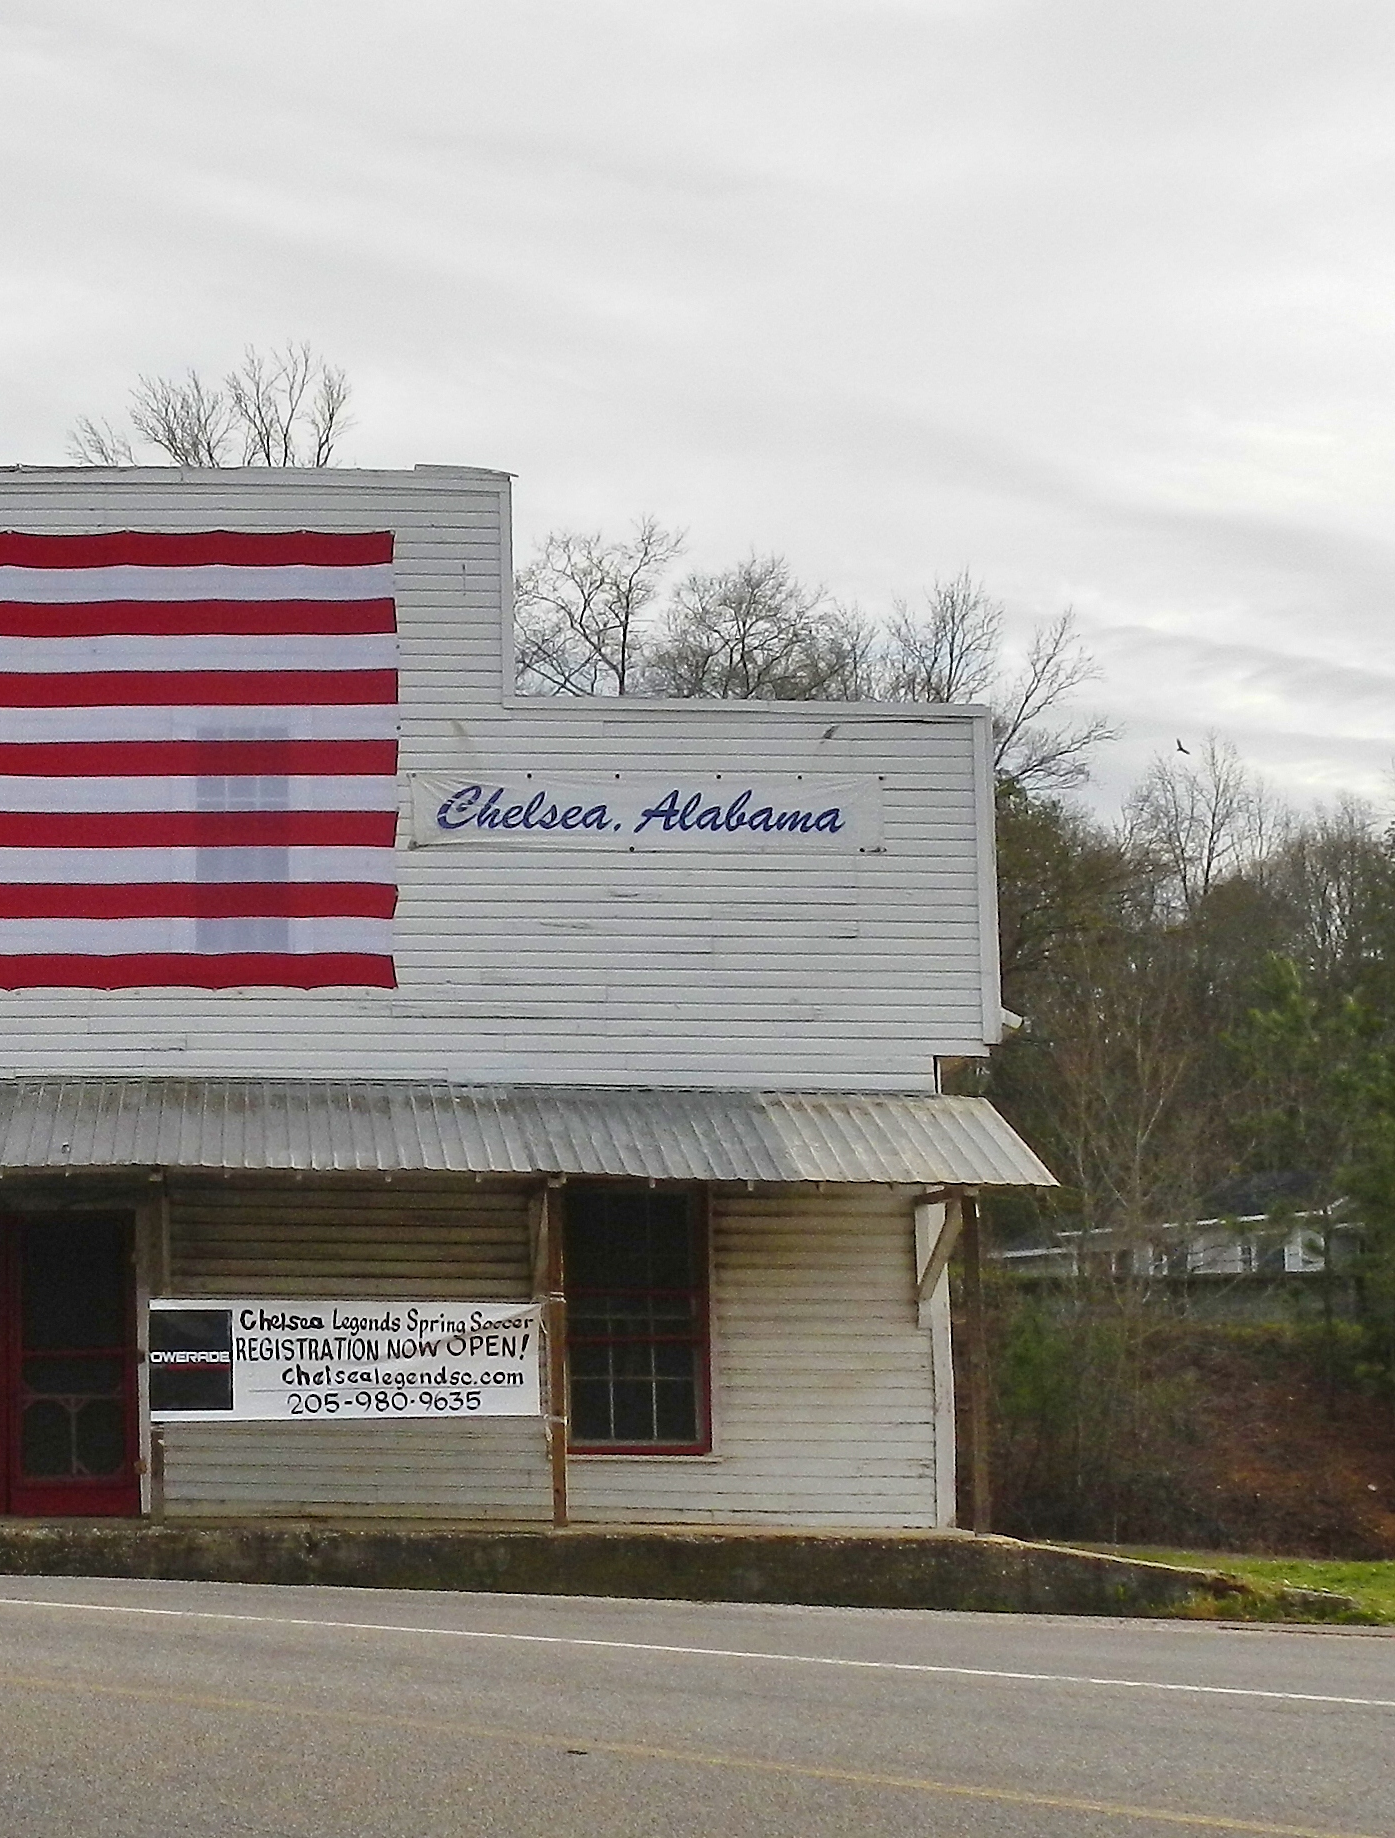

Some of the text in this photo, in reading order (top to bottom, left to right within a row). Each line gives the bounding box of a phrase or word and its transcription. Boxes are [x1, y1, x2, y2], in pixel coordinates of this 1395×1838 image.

[633, 789, 845, 834] Alabama
[240, 1308, 534, 1338] Chelsea Legends Spring Soccer
[149, 1351, 230, 1363] OWERADE
[235, 1333, 530, 1361] REGISTRATION NOW OPEN!
[282, 1363, 524, 1390] chelsealegendsc.com
